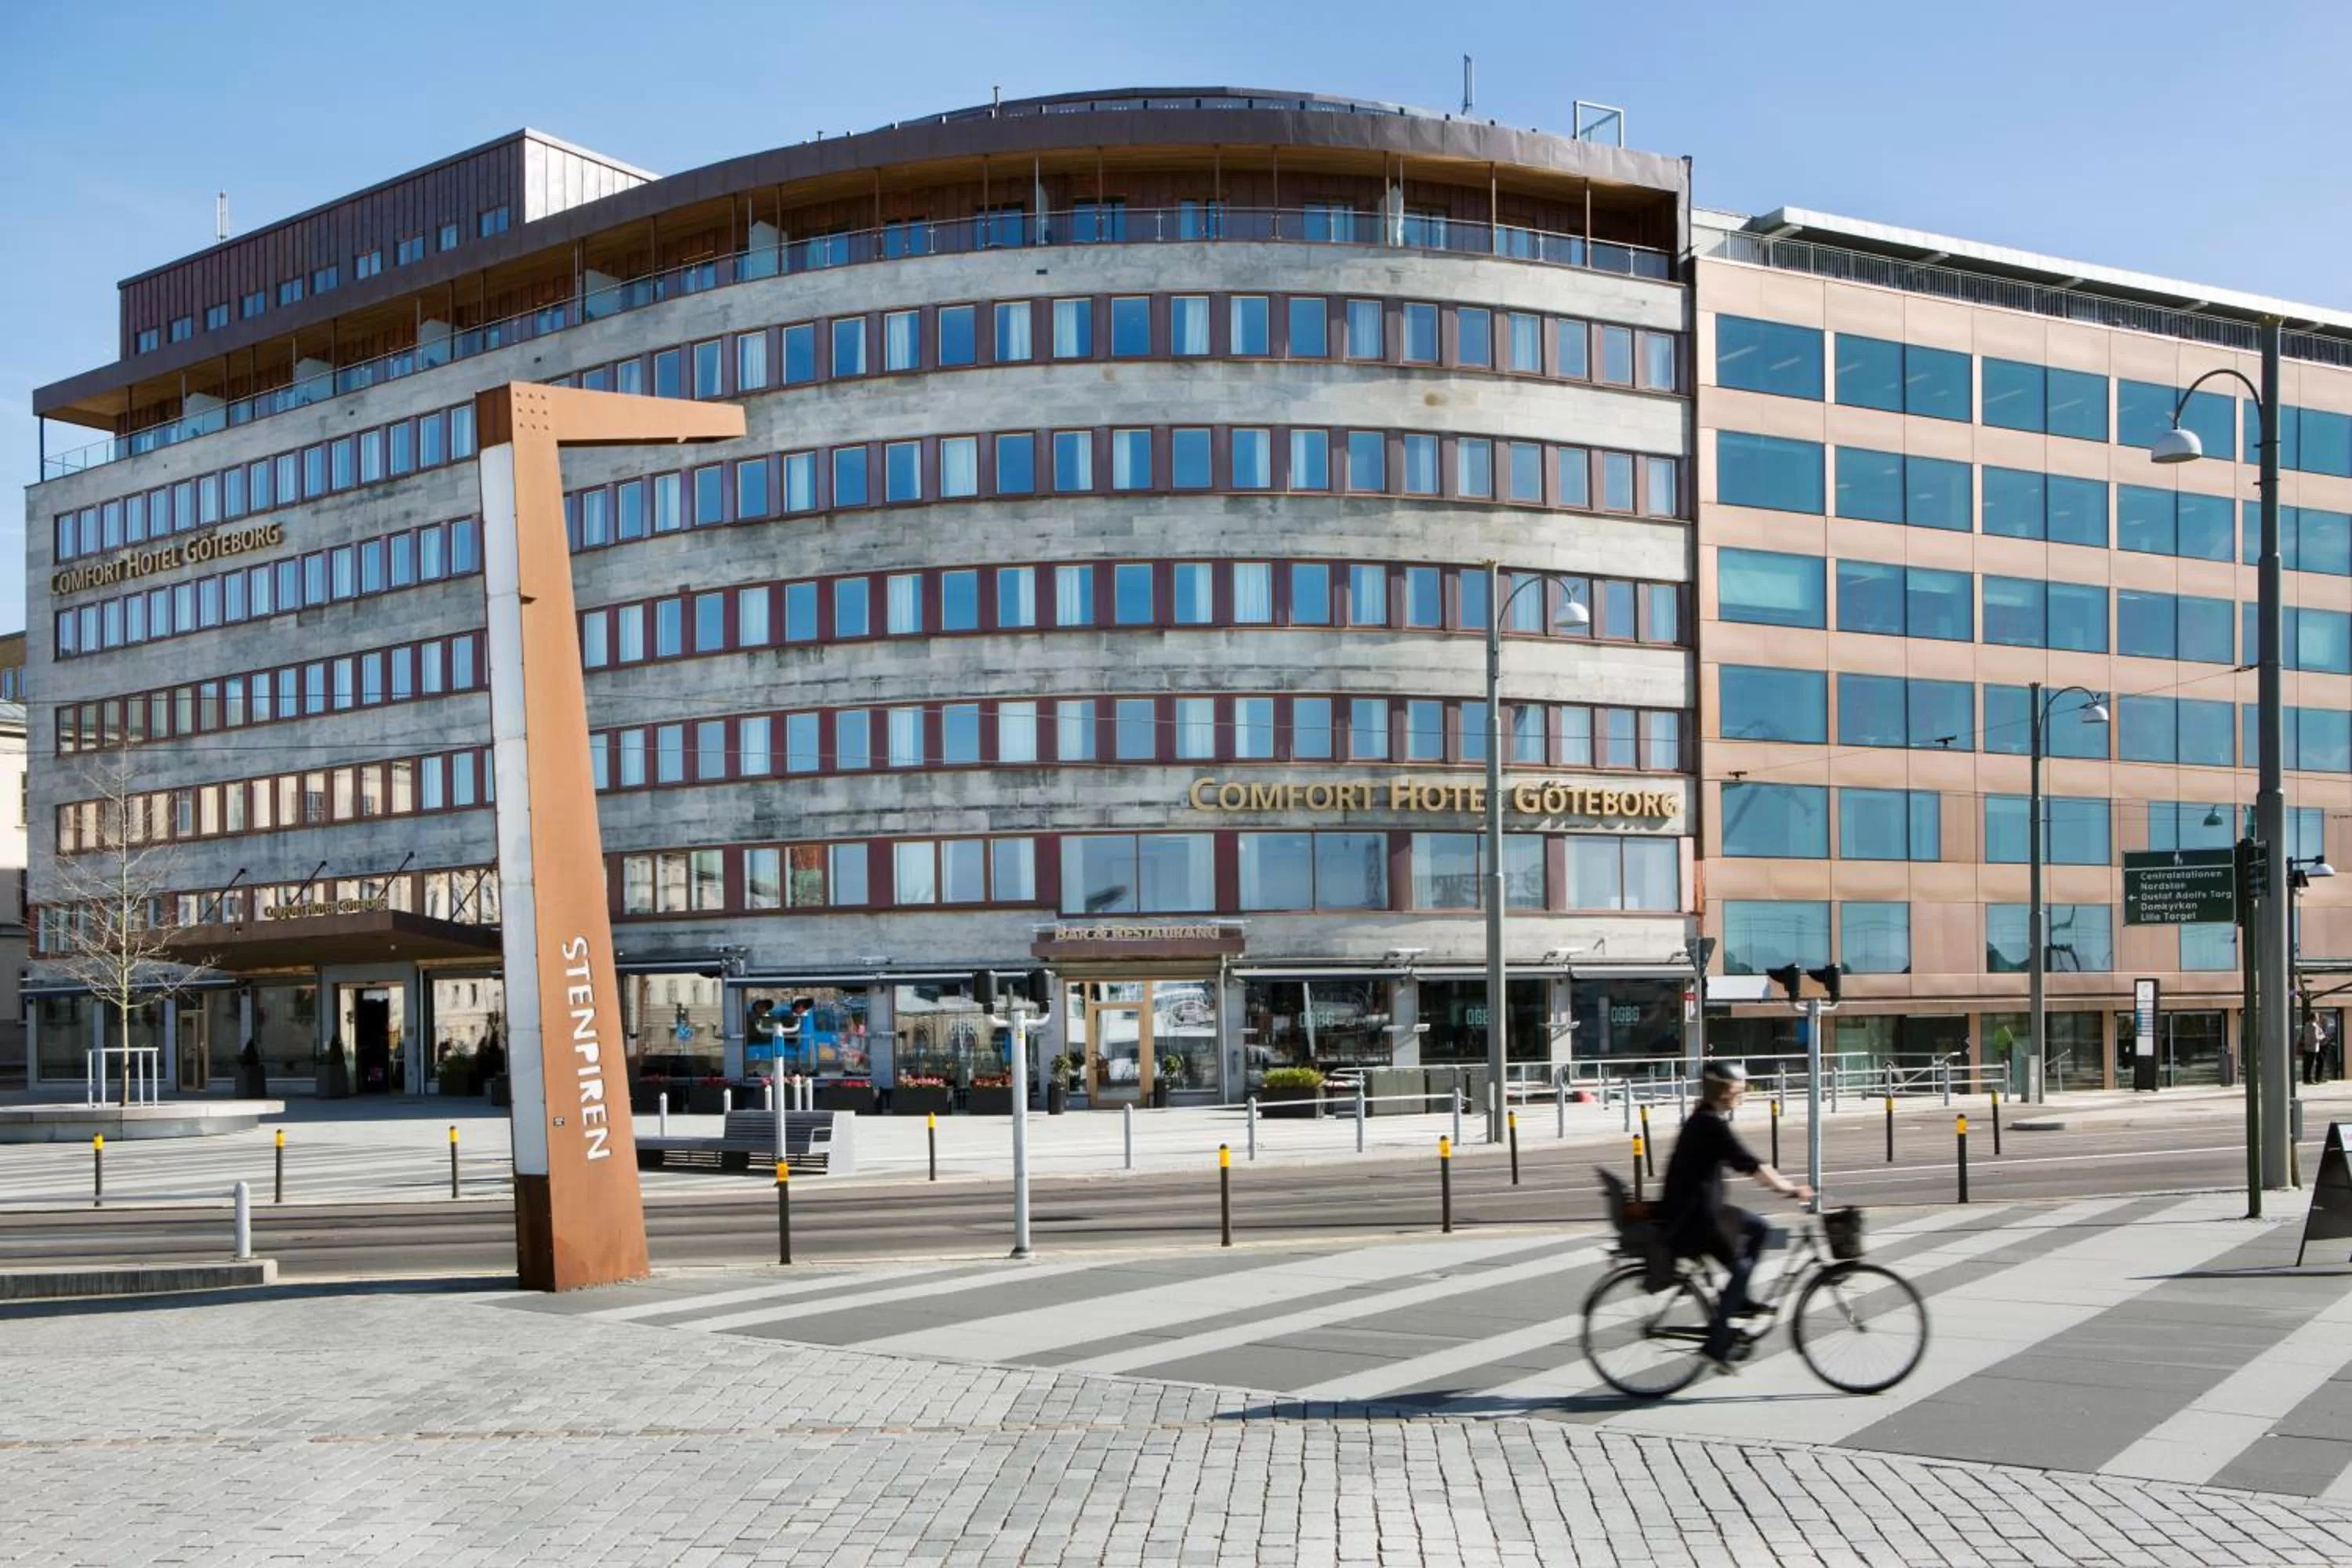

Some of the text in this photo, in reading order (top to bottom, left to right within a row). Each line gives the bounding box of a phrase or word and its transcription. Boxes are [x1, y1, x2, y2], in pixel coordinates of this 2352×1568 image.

[51, 523, 282, 596] COMFORT HOTEL GÖTEBORG
[1189, 775, 1682, 818] COMFORT HOTE GÖTEBORG
[2210, 890, 2233, 899] Torg
[1054, 926, 1087, 941] BAR
[561, 936, 613, 1160] STENPIREN
